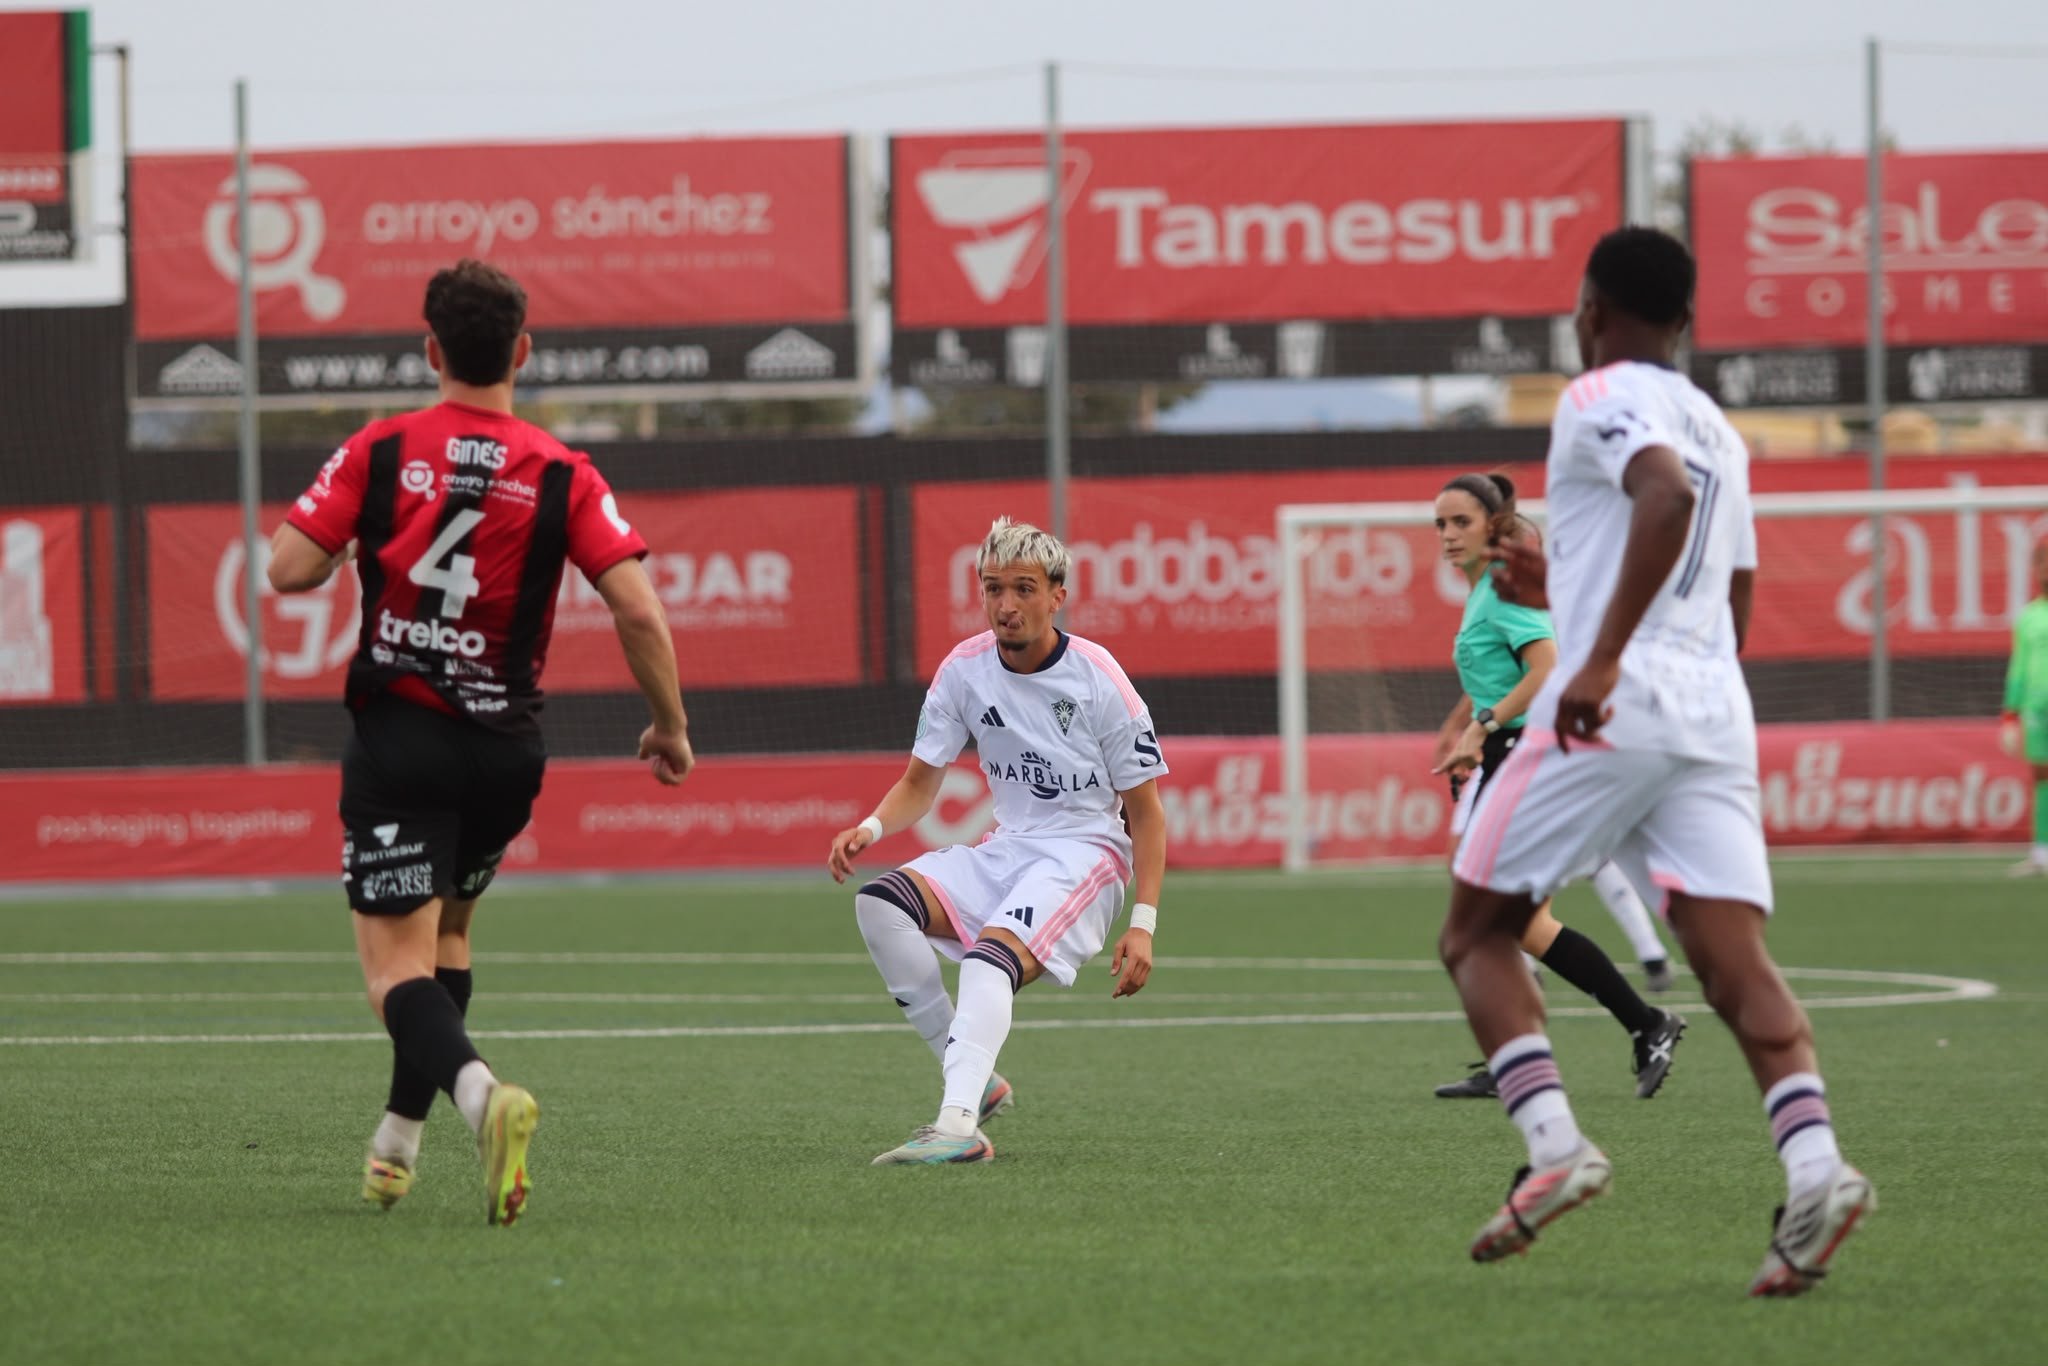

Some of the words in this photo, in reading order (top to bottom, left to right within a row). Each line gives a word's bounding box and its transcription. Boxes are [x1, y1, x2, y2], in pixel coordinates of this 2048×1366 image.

[363, 198, 540, 257] arroyo
[551, 173, 773, 238] sánchez
[1090, 187, 1582, 268] Tamesur
[441, 474, 485, 488] arroyo
[408, 508, 487, 619] 4
[1134, 730, 1162, 768] S
[1795, 740, 1842, 779] El
[989, 760, 1100, 793] MARBELLA
[1215, 754, 1262, 794] El
